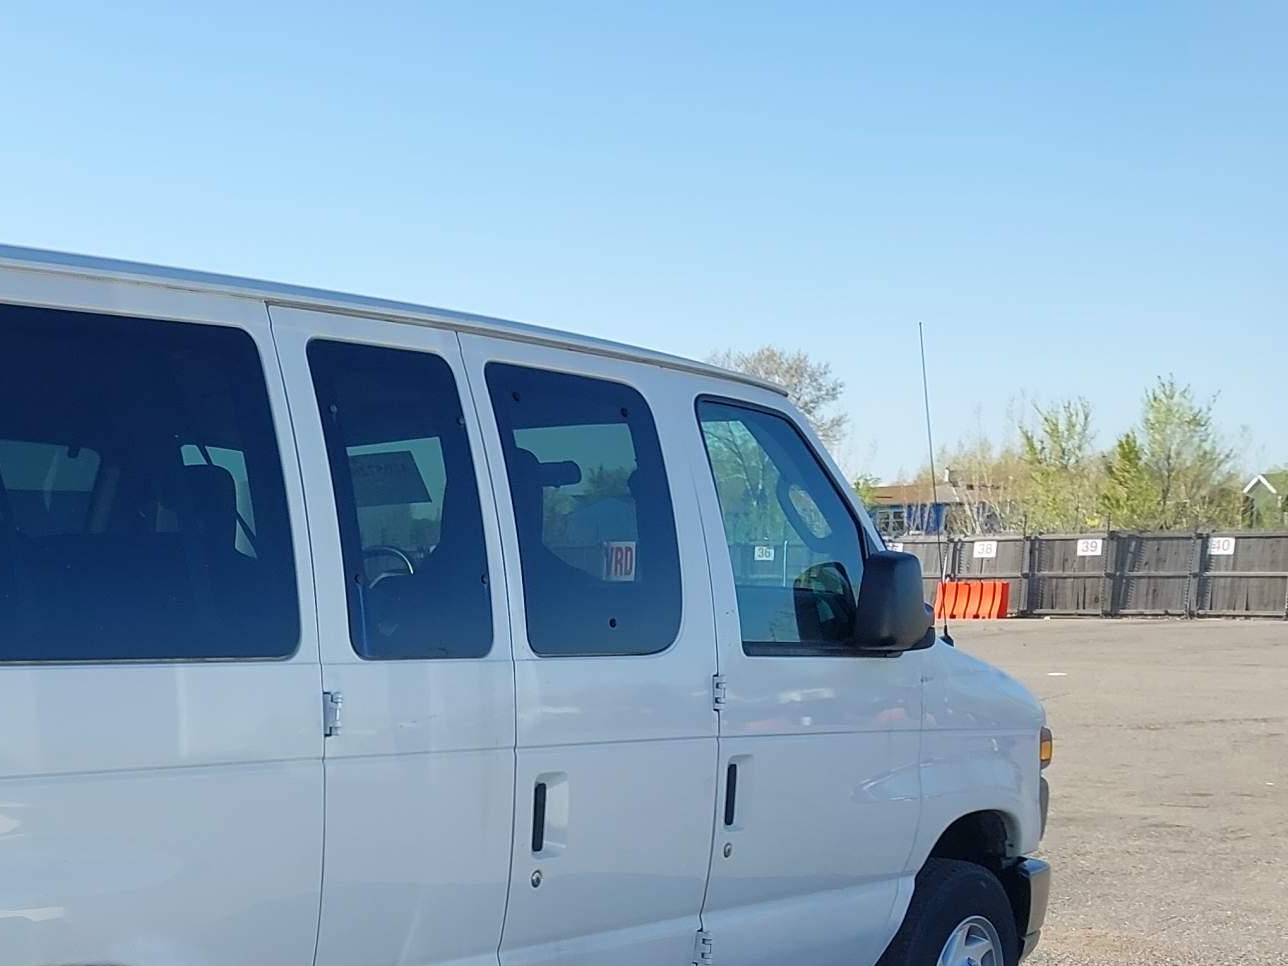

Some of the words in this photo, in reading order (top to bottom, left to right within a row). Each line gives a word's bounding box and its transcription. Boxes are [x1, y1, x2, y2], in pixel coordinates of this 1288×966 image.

[977, 543, 993, 555] 38
[1081, 540, 1098, 553] 39
[1211, 538, 1231, 552] 40
[757, 547, 771, 558] 36
